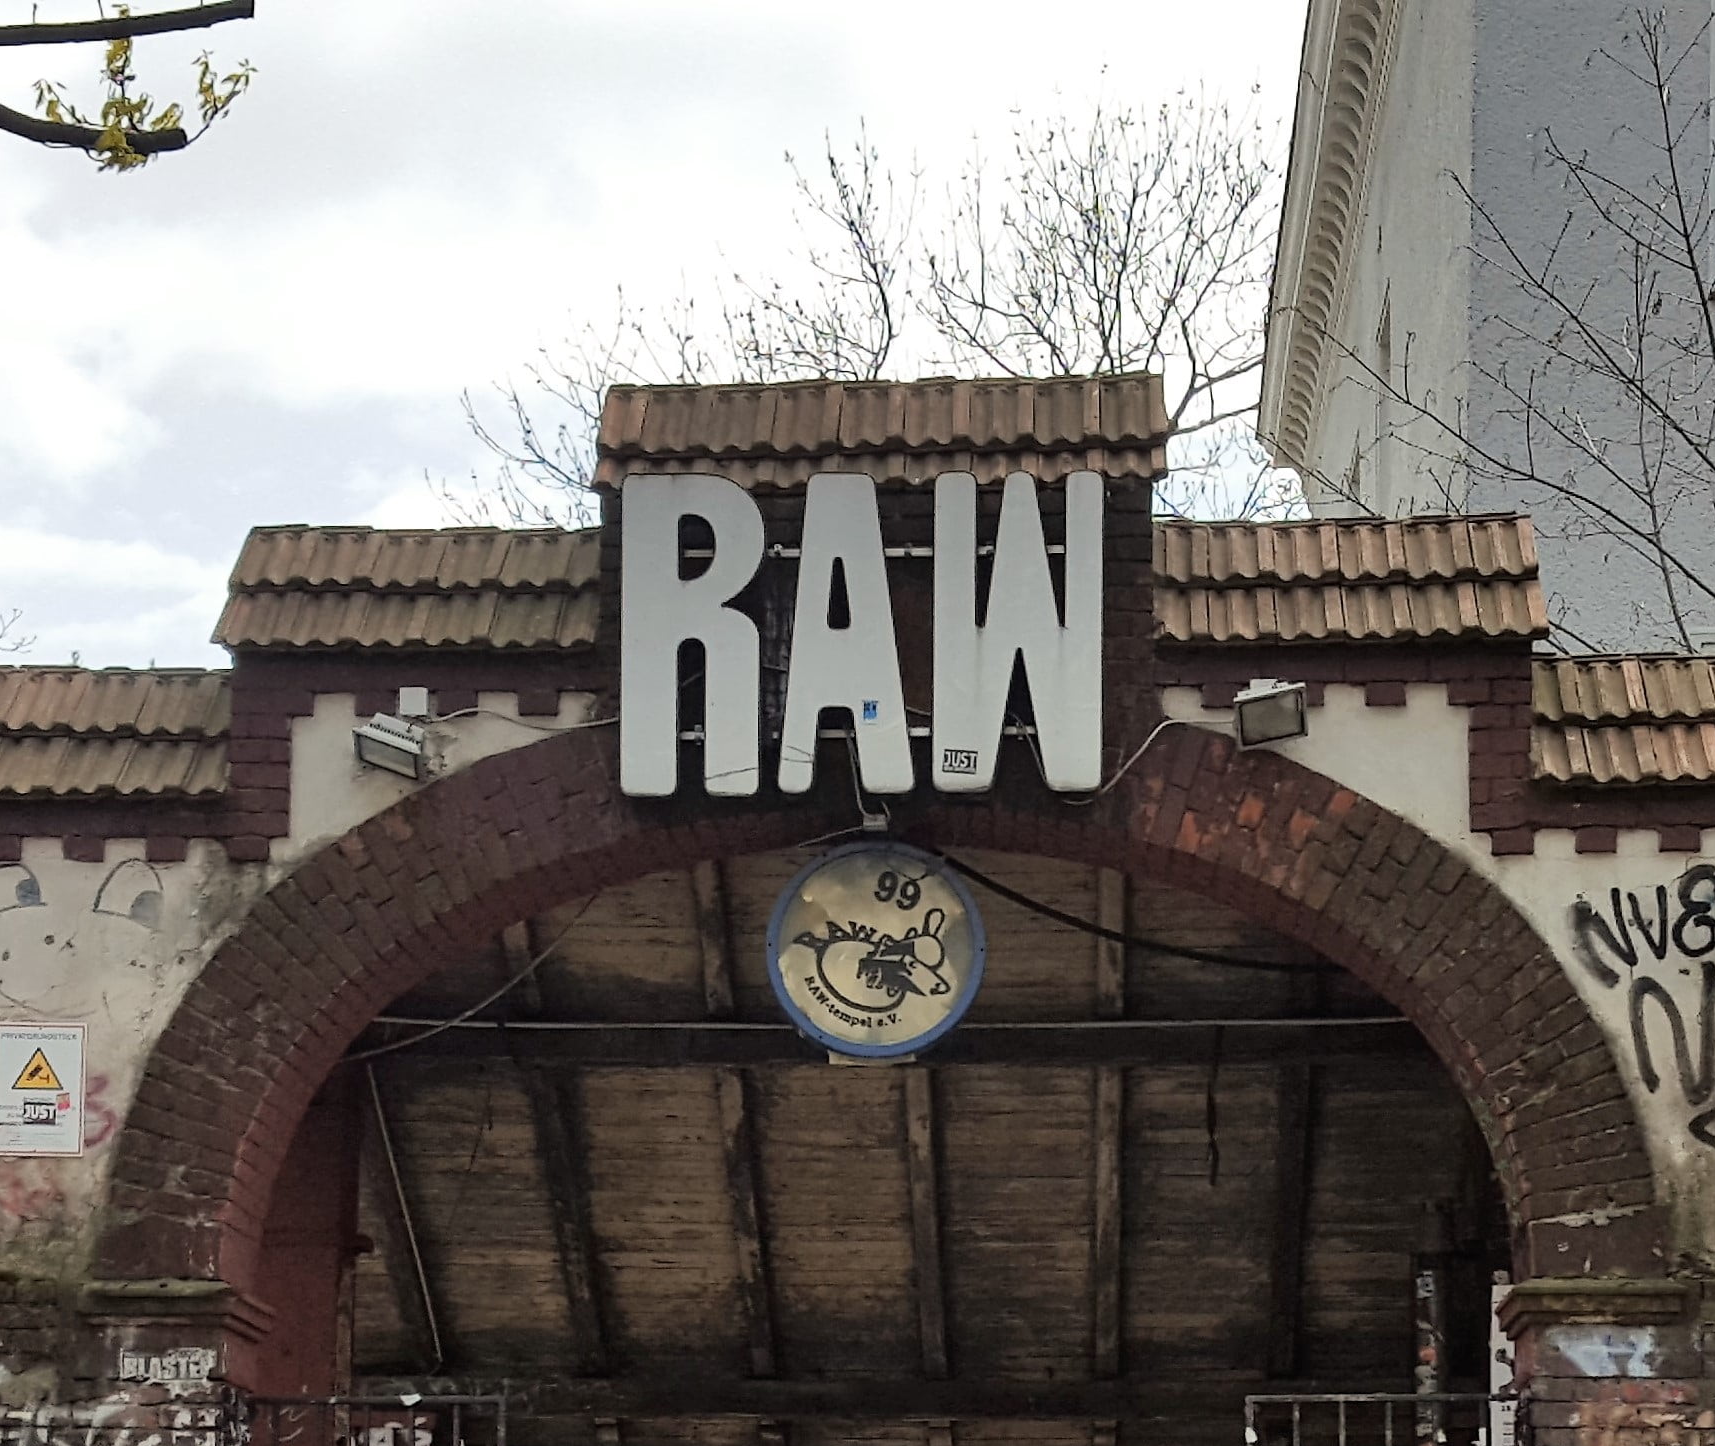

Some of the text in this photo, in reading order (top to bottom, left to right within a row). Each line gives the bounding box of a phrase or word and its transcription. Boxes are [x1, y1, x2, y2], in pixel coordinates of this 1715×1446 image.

[620, 470, 1103, 796] RAW
[944, 751, 977, 769] JUST
[874, 871, 921, 911] 99
[804, 976, 873, 1028] RAW-tempel
[23, 1103, 56, 1121] JUST
